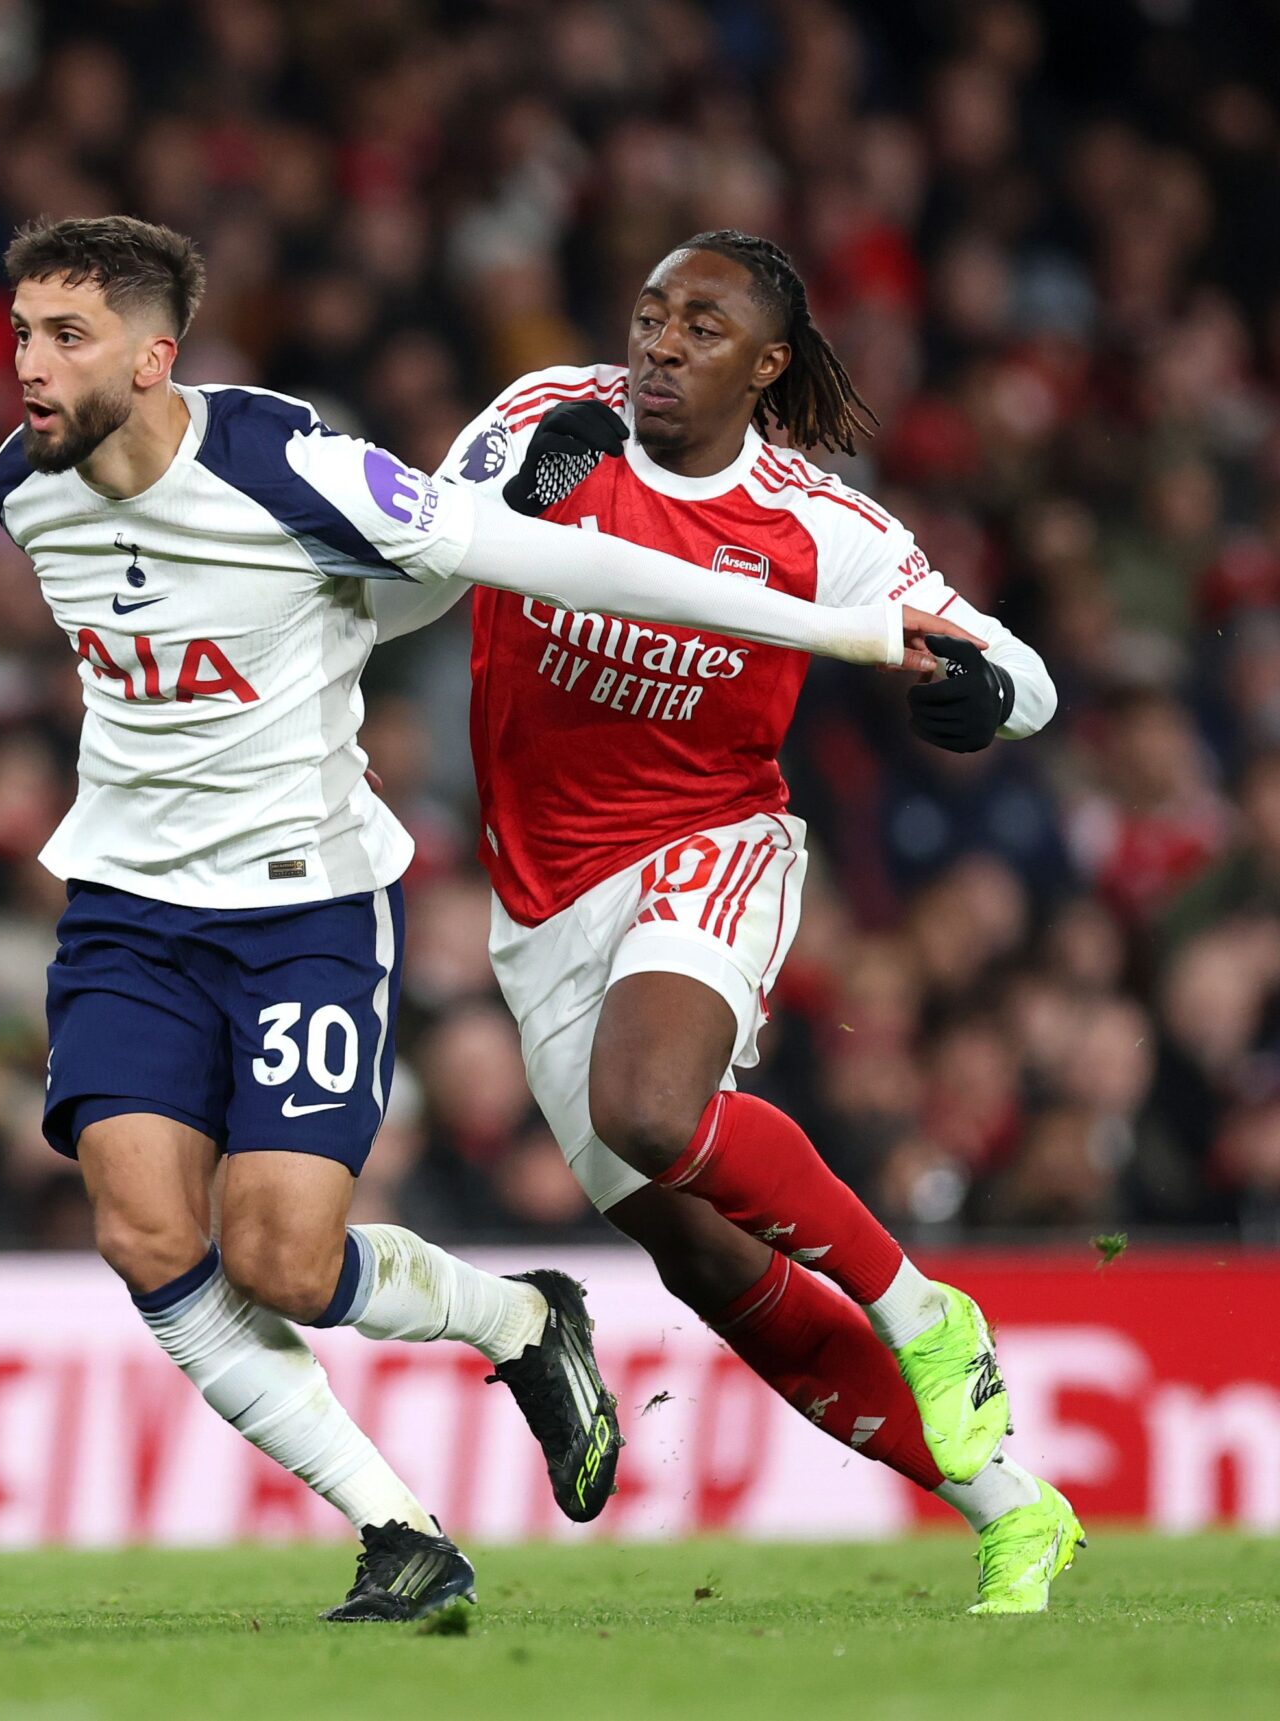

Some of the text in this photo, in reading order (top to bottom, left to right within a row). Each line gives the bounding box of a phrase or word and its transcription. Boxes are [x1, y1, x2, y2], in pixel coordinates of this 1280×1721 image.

[721, 554, 761, 573] Arsenal
[78, 628, 261, 704] AIA
[537, 642, 704, 721] FLY BETTER
[252, 1002, 359, 1094] 30
